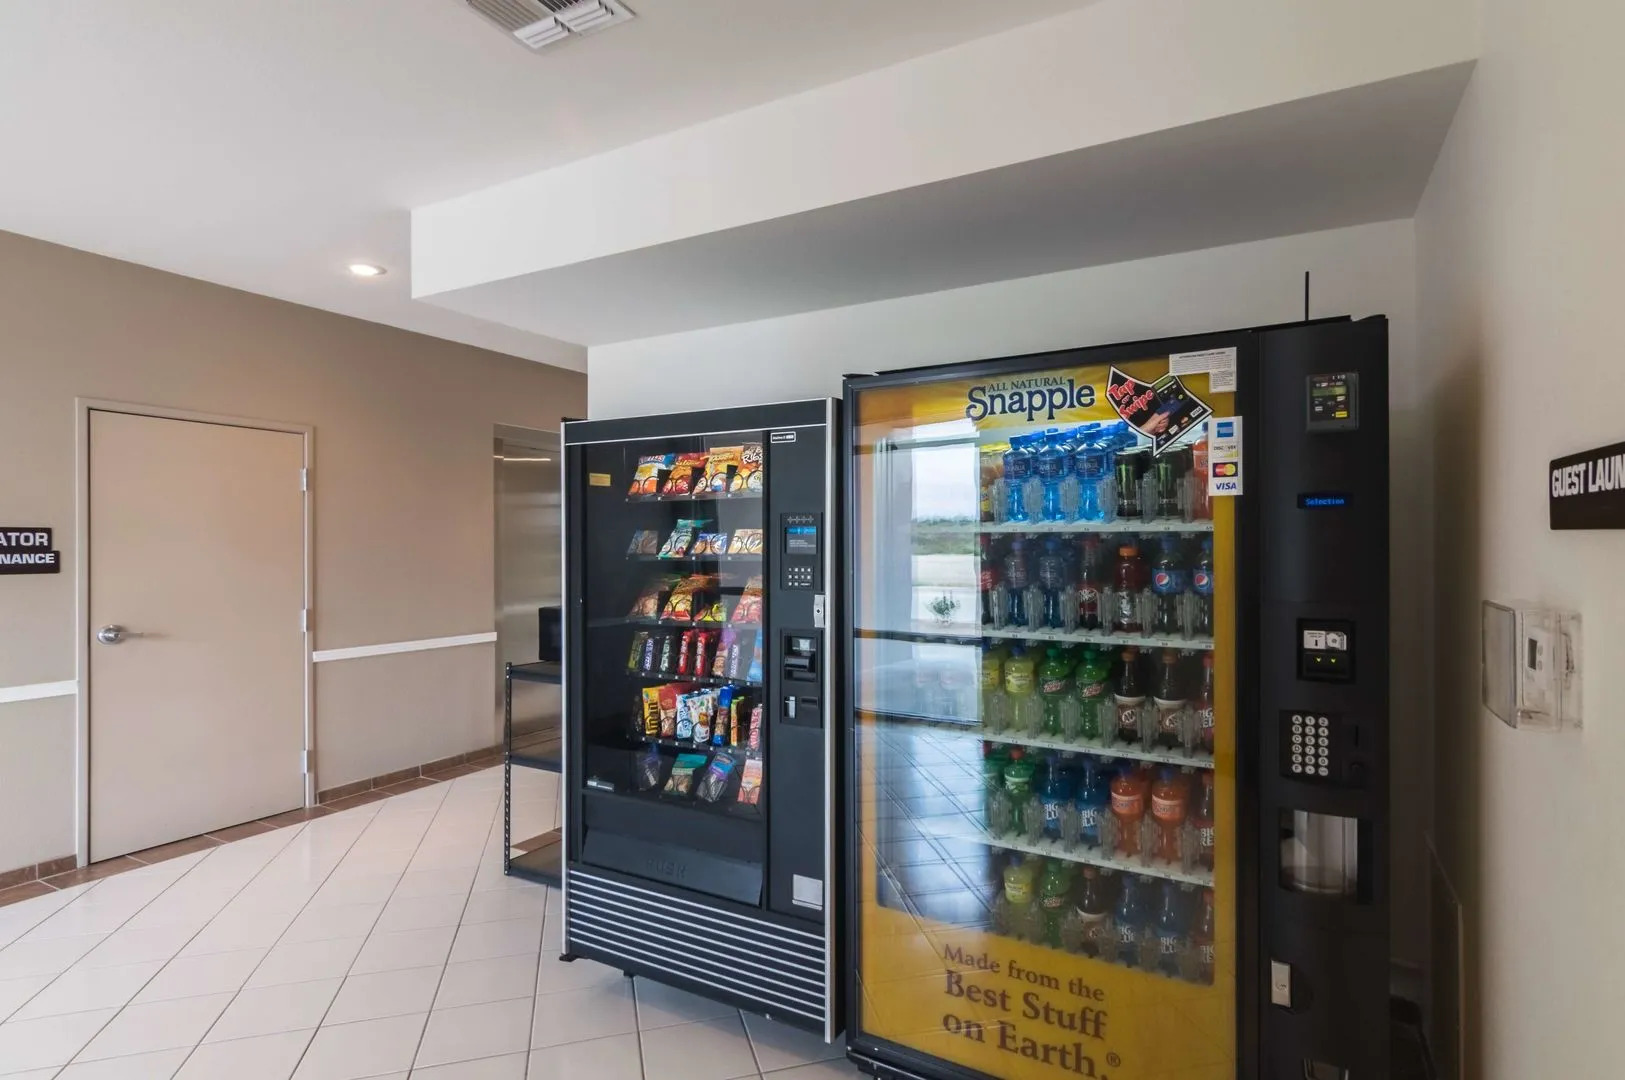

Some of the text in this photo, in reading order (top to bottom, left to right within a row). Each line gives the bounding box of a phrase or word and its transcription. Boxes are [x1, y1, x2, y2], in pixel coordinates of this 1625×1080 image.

[988, 377, 1066, 392] ALL NATURAL
[1108, 379, 1135, 401] Tap
[966, 379, 1095, 421] Snapple
[1120, 389, 1154, 420] Swipe
[1216, 482, 1237, 490] VISA
[1552, 453, 1625, 498] GUEST LAUN
[0, 553, 55, 564] NANCE
[944, 944, 1105, 1002] Made from the
[944, 969, 1108, 1040] Best Stuff
[943, 1014, 985, 1043] on
